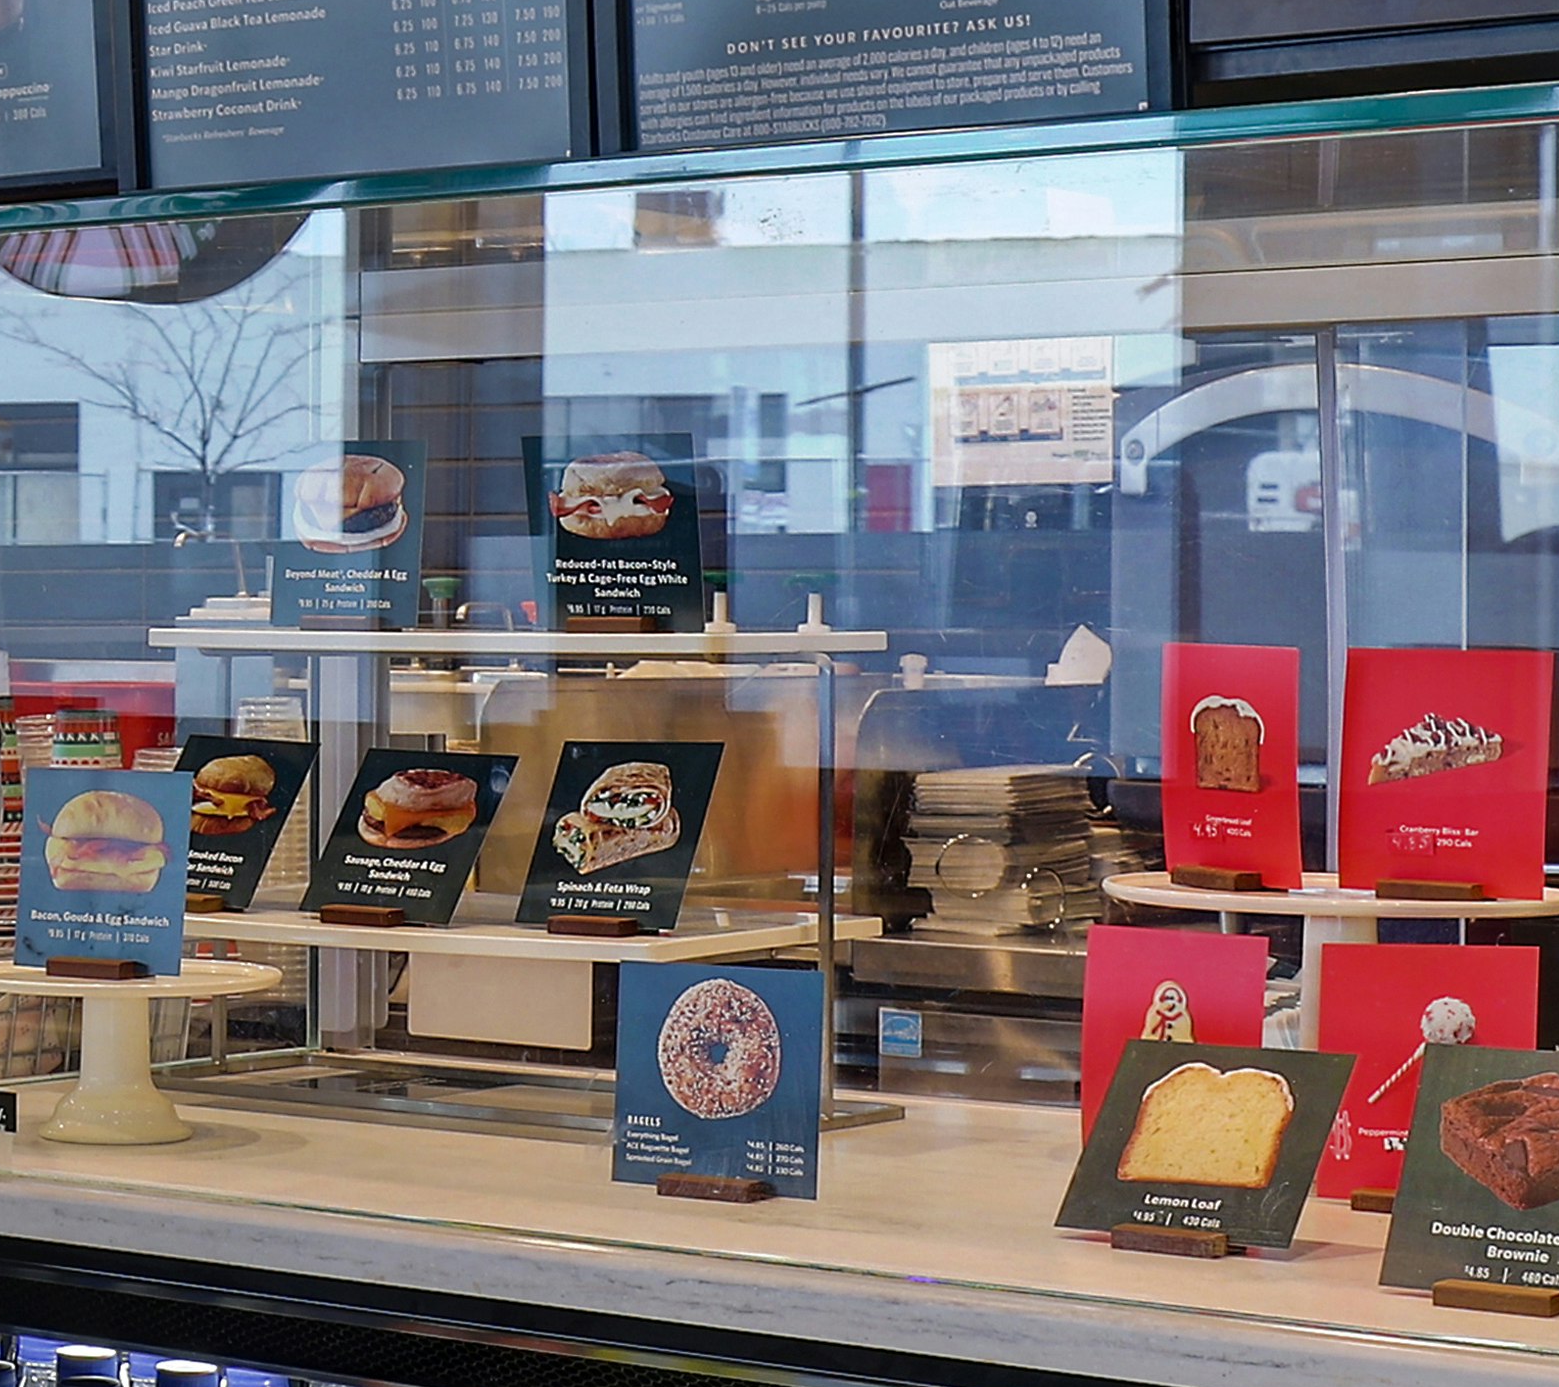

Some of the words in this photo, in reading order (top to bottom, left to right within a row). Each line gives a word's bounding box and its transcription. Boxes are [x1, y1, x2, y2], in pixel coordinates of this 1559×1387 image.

[727, 38, 773, 55] DON'T
[782, 35, 808, 50] SEE
[814, 30, 858, 46] YOUR
[863, 22, 960, 41] FAVOURITE?
[966, 18, 997, 32] ASK
[1003, 14, 1032, 28] US!
[557, 881, 593, 893] Spinach
[594, 882, 602, 892] &
[603, 882, 624, 893] Feta
[625, 884, 651, 896] Wrap
[1144, 1193, 1188, 1210] Lemon
[1190, 1196, 1222, 1211] Loaf
[1431, 1222, 1484, 1241] Double
[1486, 1245, 1549, 1264] Brownie
